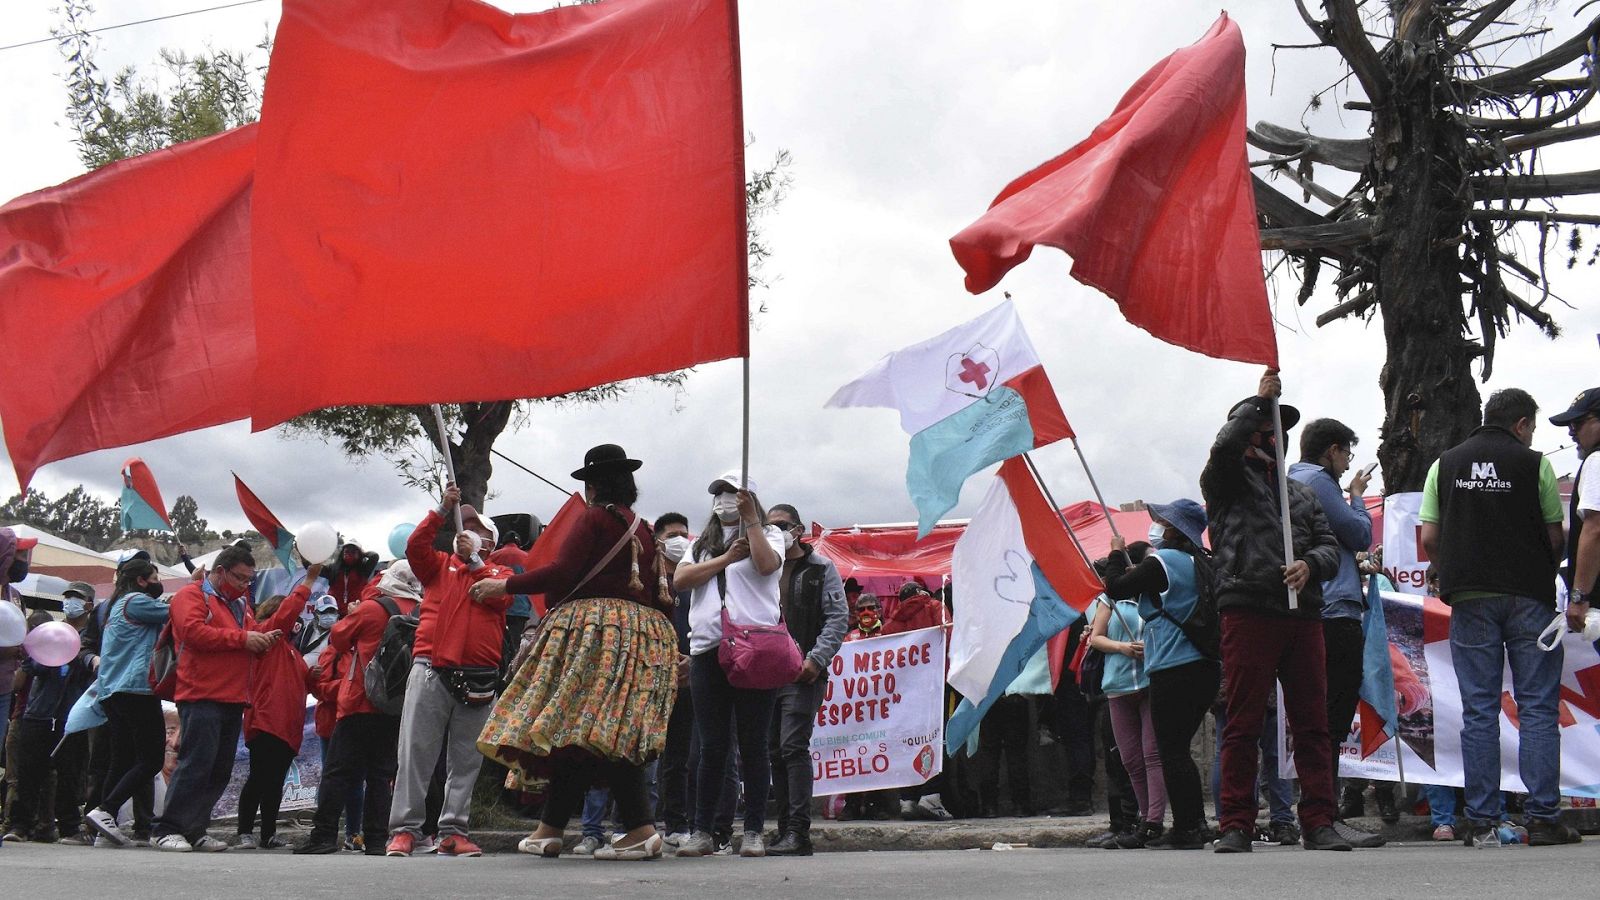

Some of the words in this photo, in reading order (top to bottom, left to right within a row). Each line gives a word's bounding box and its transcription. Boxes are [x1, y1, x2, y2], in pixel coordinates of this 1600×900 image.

[1471, 462, 1498, 480] NA
[1455, 479, 1484, 490] Negro
[1486, 479, 1512, 489] Arias
[1384, 566, 1425, 588] Neg
[829, 655, 844, 676] O
[854, 643, 931, 673] MERECE
[824, 680, 834, 702] U
[843, 672, 896, 699] VOTO
[813, 737, 825, 746] EL
[827, 735, 849, 745] BIEN
[812, 742, 888, 760] omos
[812, 754, 889, 781] UEBLO
